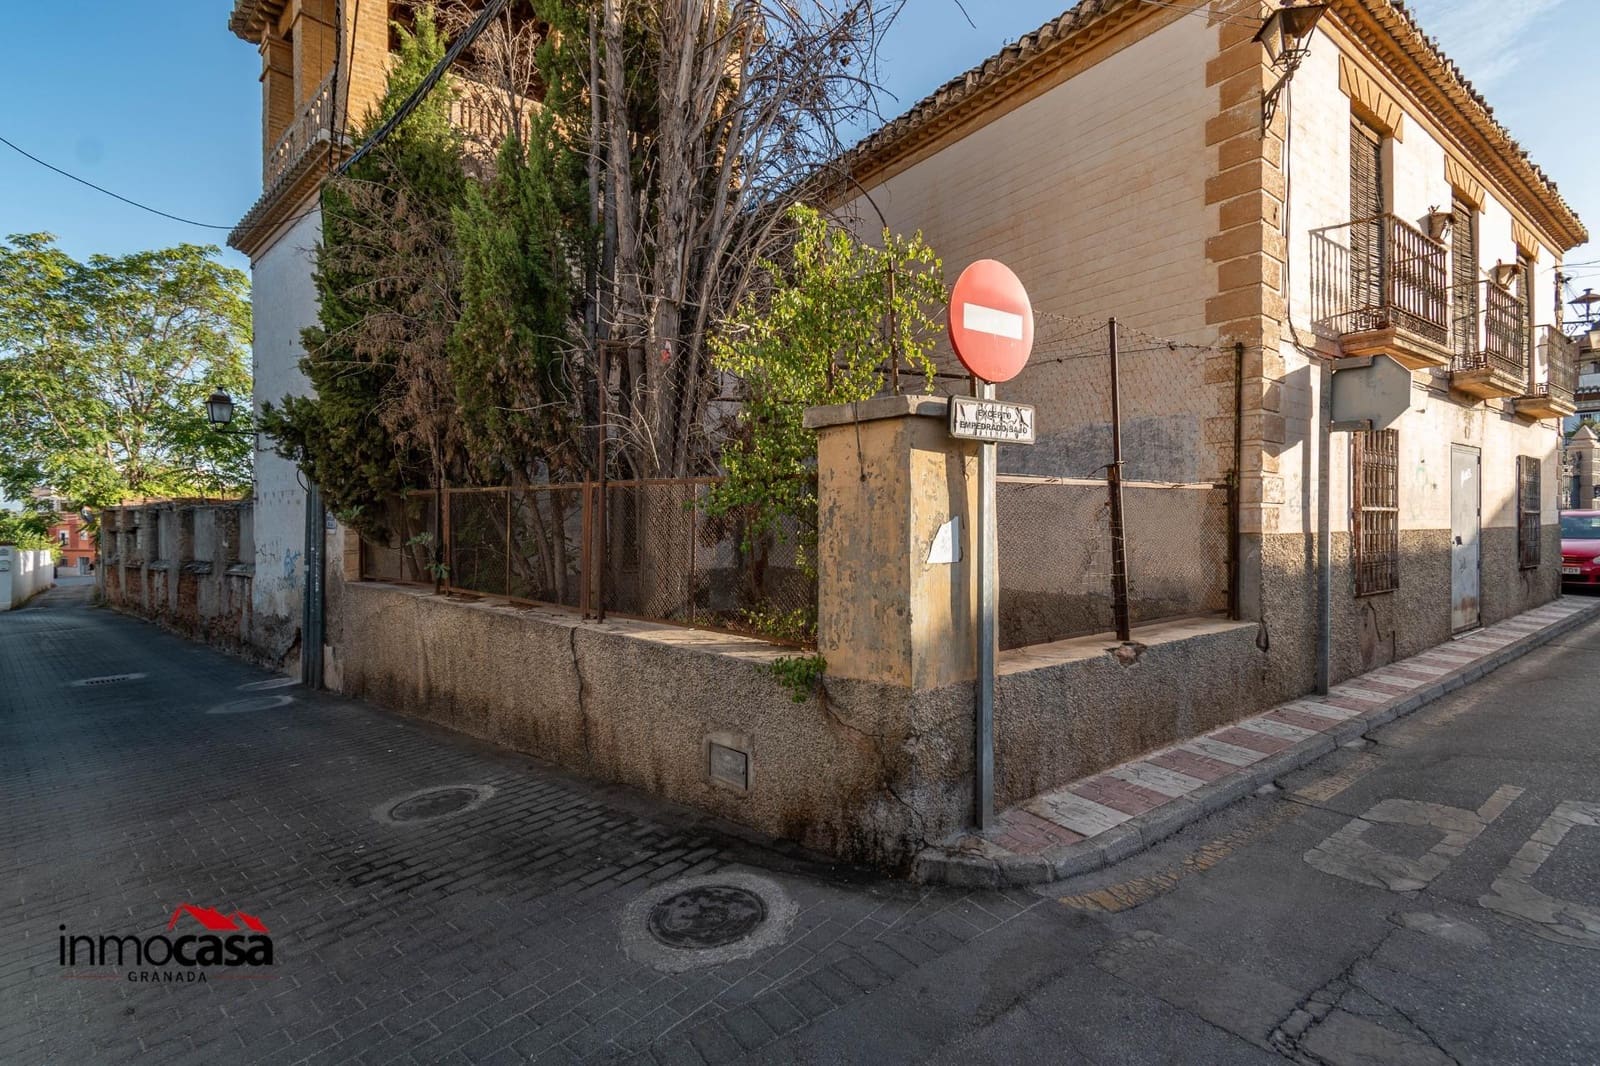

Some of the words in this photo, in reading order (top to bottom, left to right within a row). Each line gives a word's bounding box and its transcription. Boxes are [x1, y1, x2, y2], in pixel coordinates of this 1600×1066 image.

[977, 410, 1012, 420] EXCEPTO
[960, 420, 1007, 432] EMPEDRADO
[1008, 424, 1028, 434] BAJO
